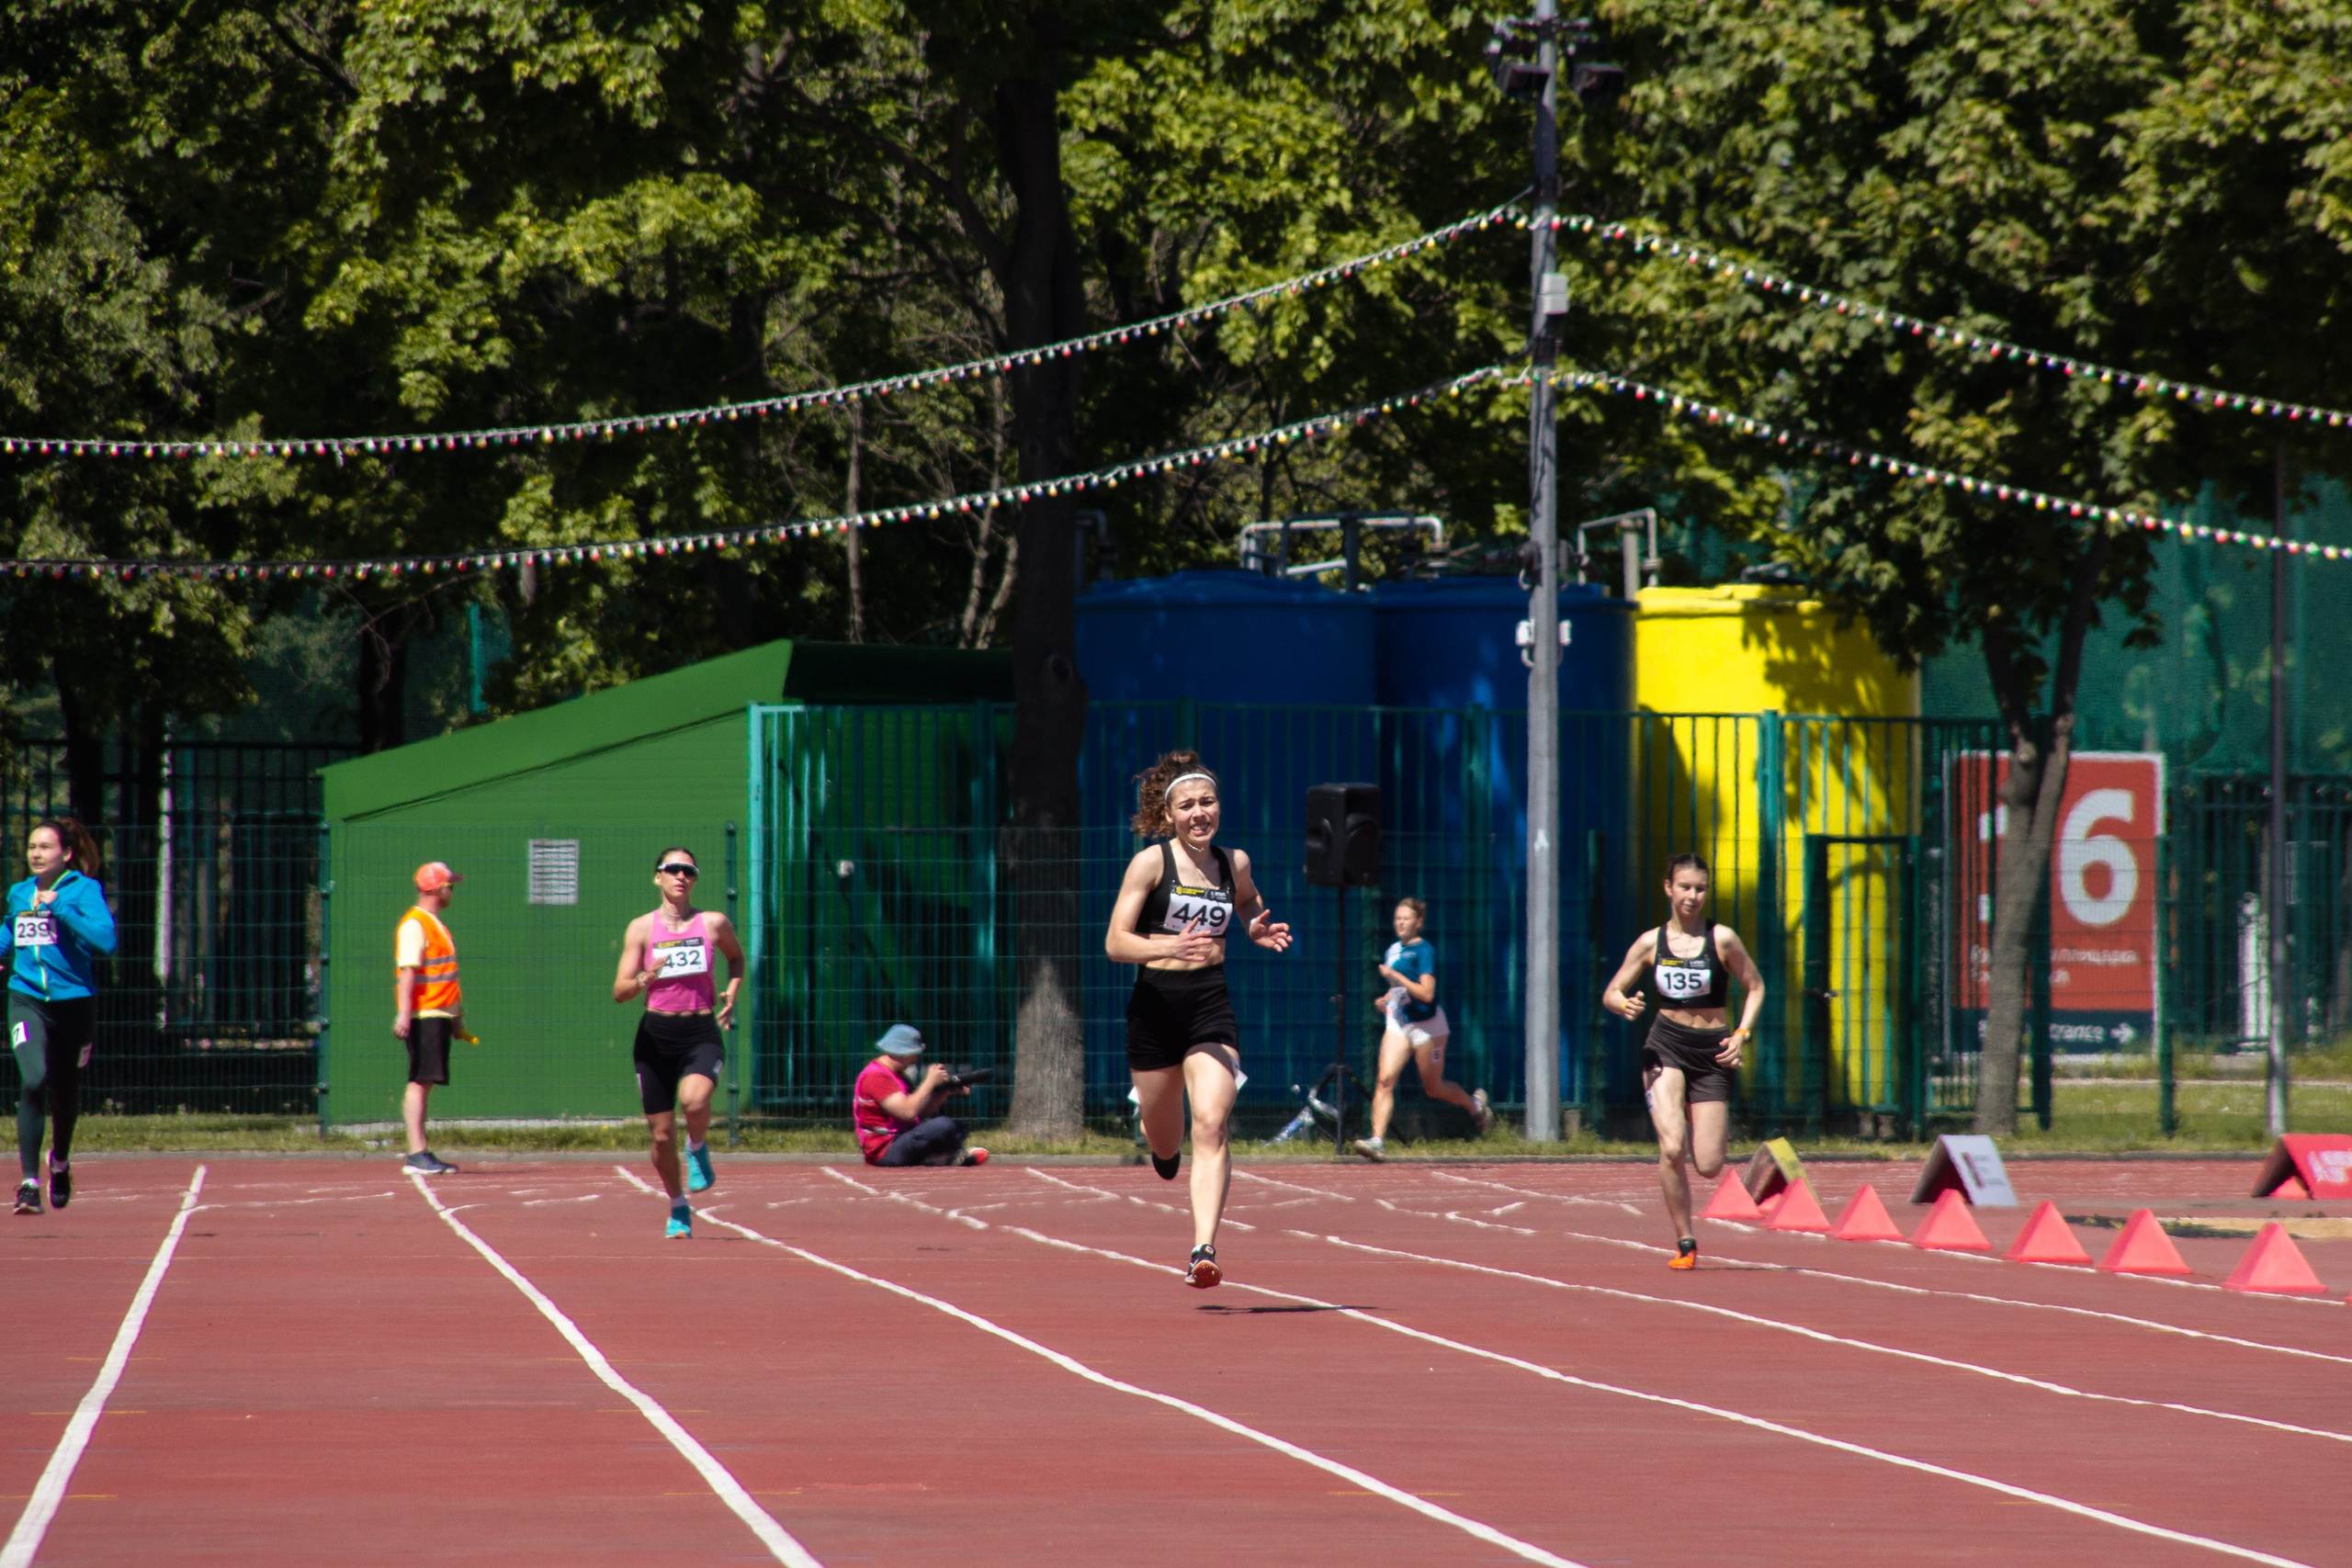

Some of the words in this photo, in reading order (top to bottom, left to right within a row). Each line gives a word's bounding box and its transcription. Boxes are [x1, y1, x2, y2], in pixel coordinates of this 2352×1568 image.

[1171, 902, 1227, 928] 449
[17, 921, 50, 939] 239
[663, 949, 702, 968] 432
[1663, 972, 1702, 990] 135
